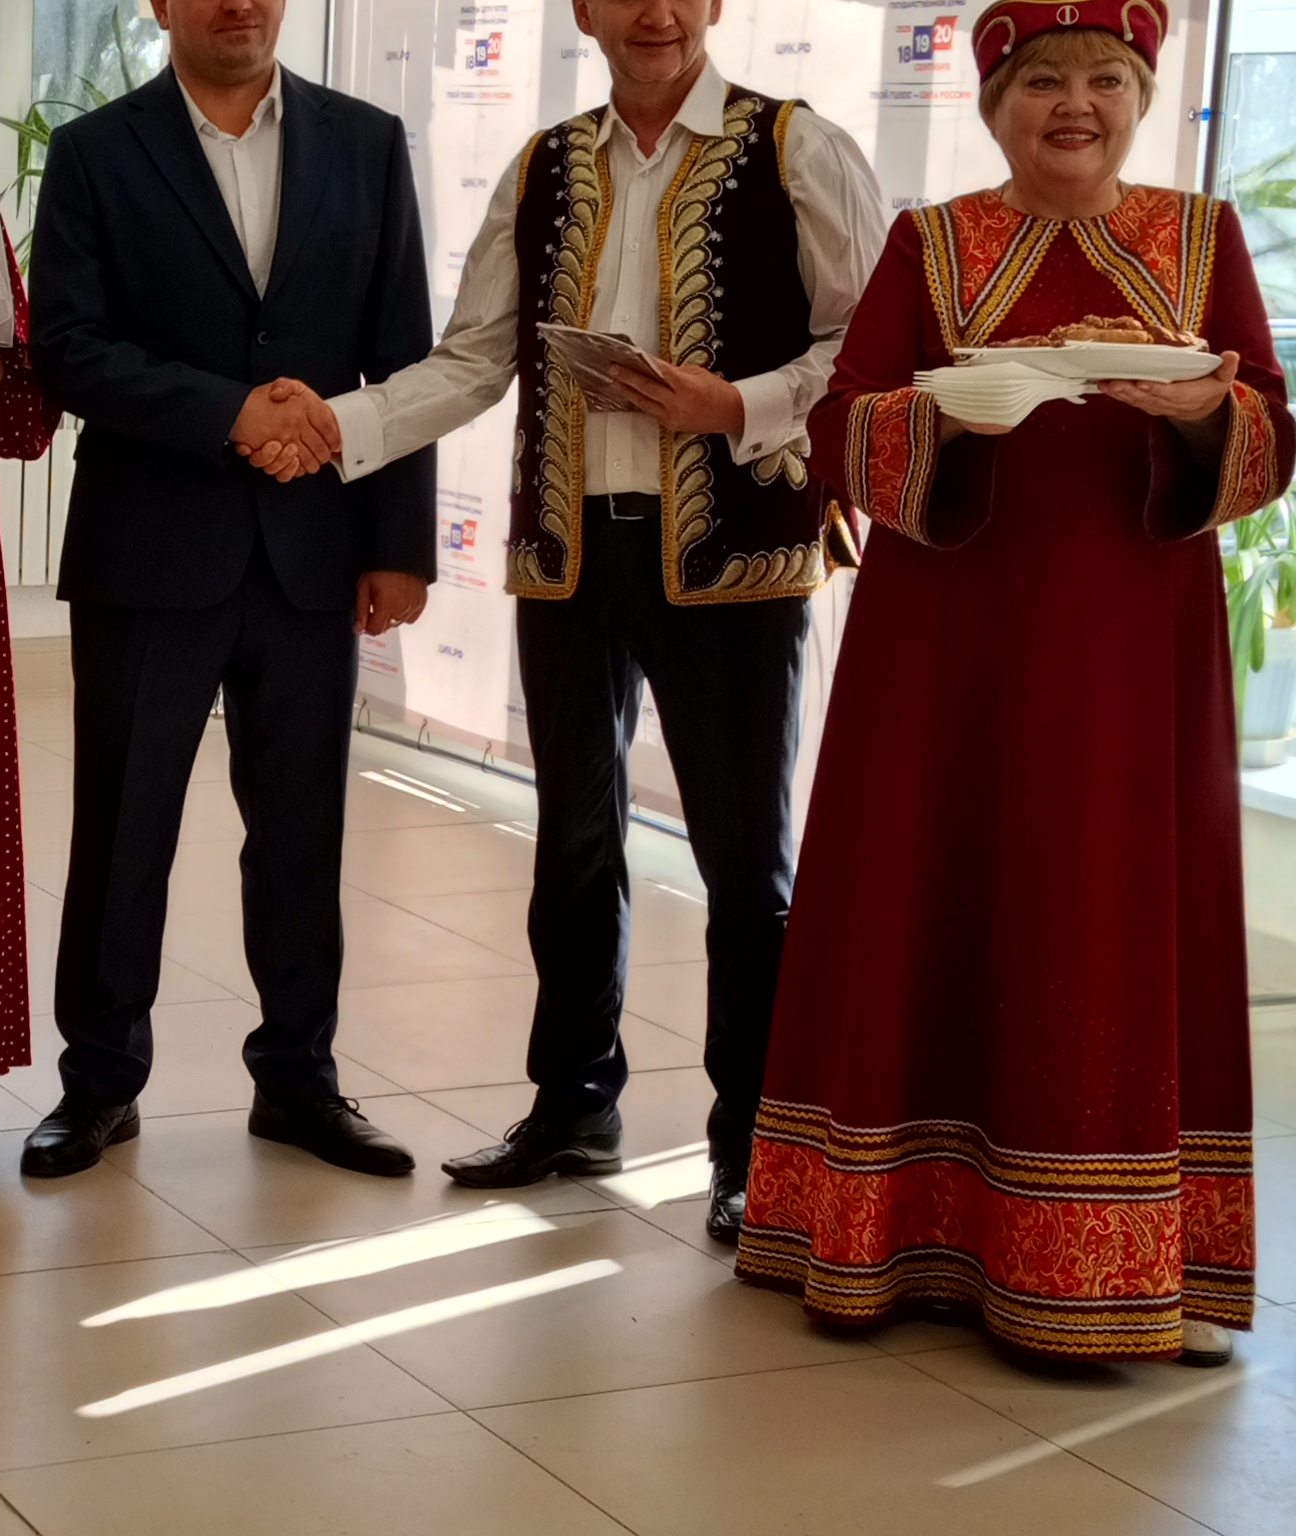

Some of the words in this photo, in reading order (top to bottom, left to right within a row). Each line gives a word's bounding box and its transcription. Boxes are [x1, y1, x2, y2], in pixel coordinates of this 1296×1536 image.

[933, 24, 952, 43] 20
[915, 34, 929, 53] 19
[898, 46, 911, 63] 18
